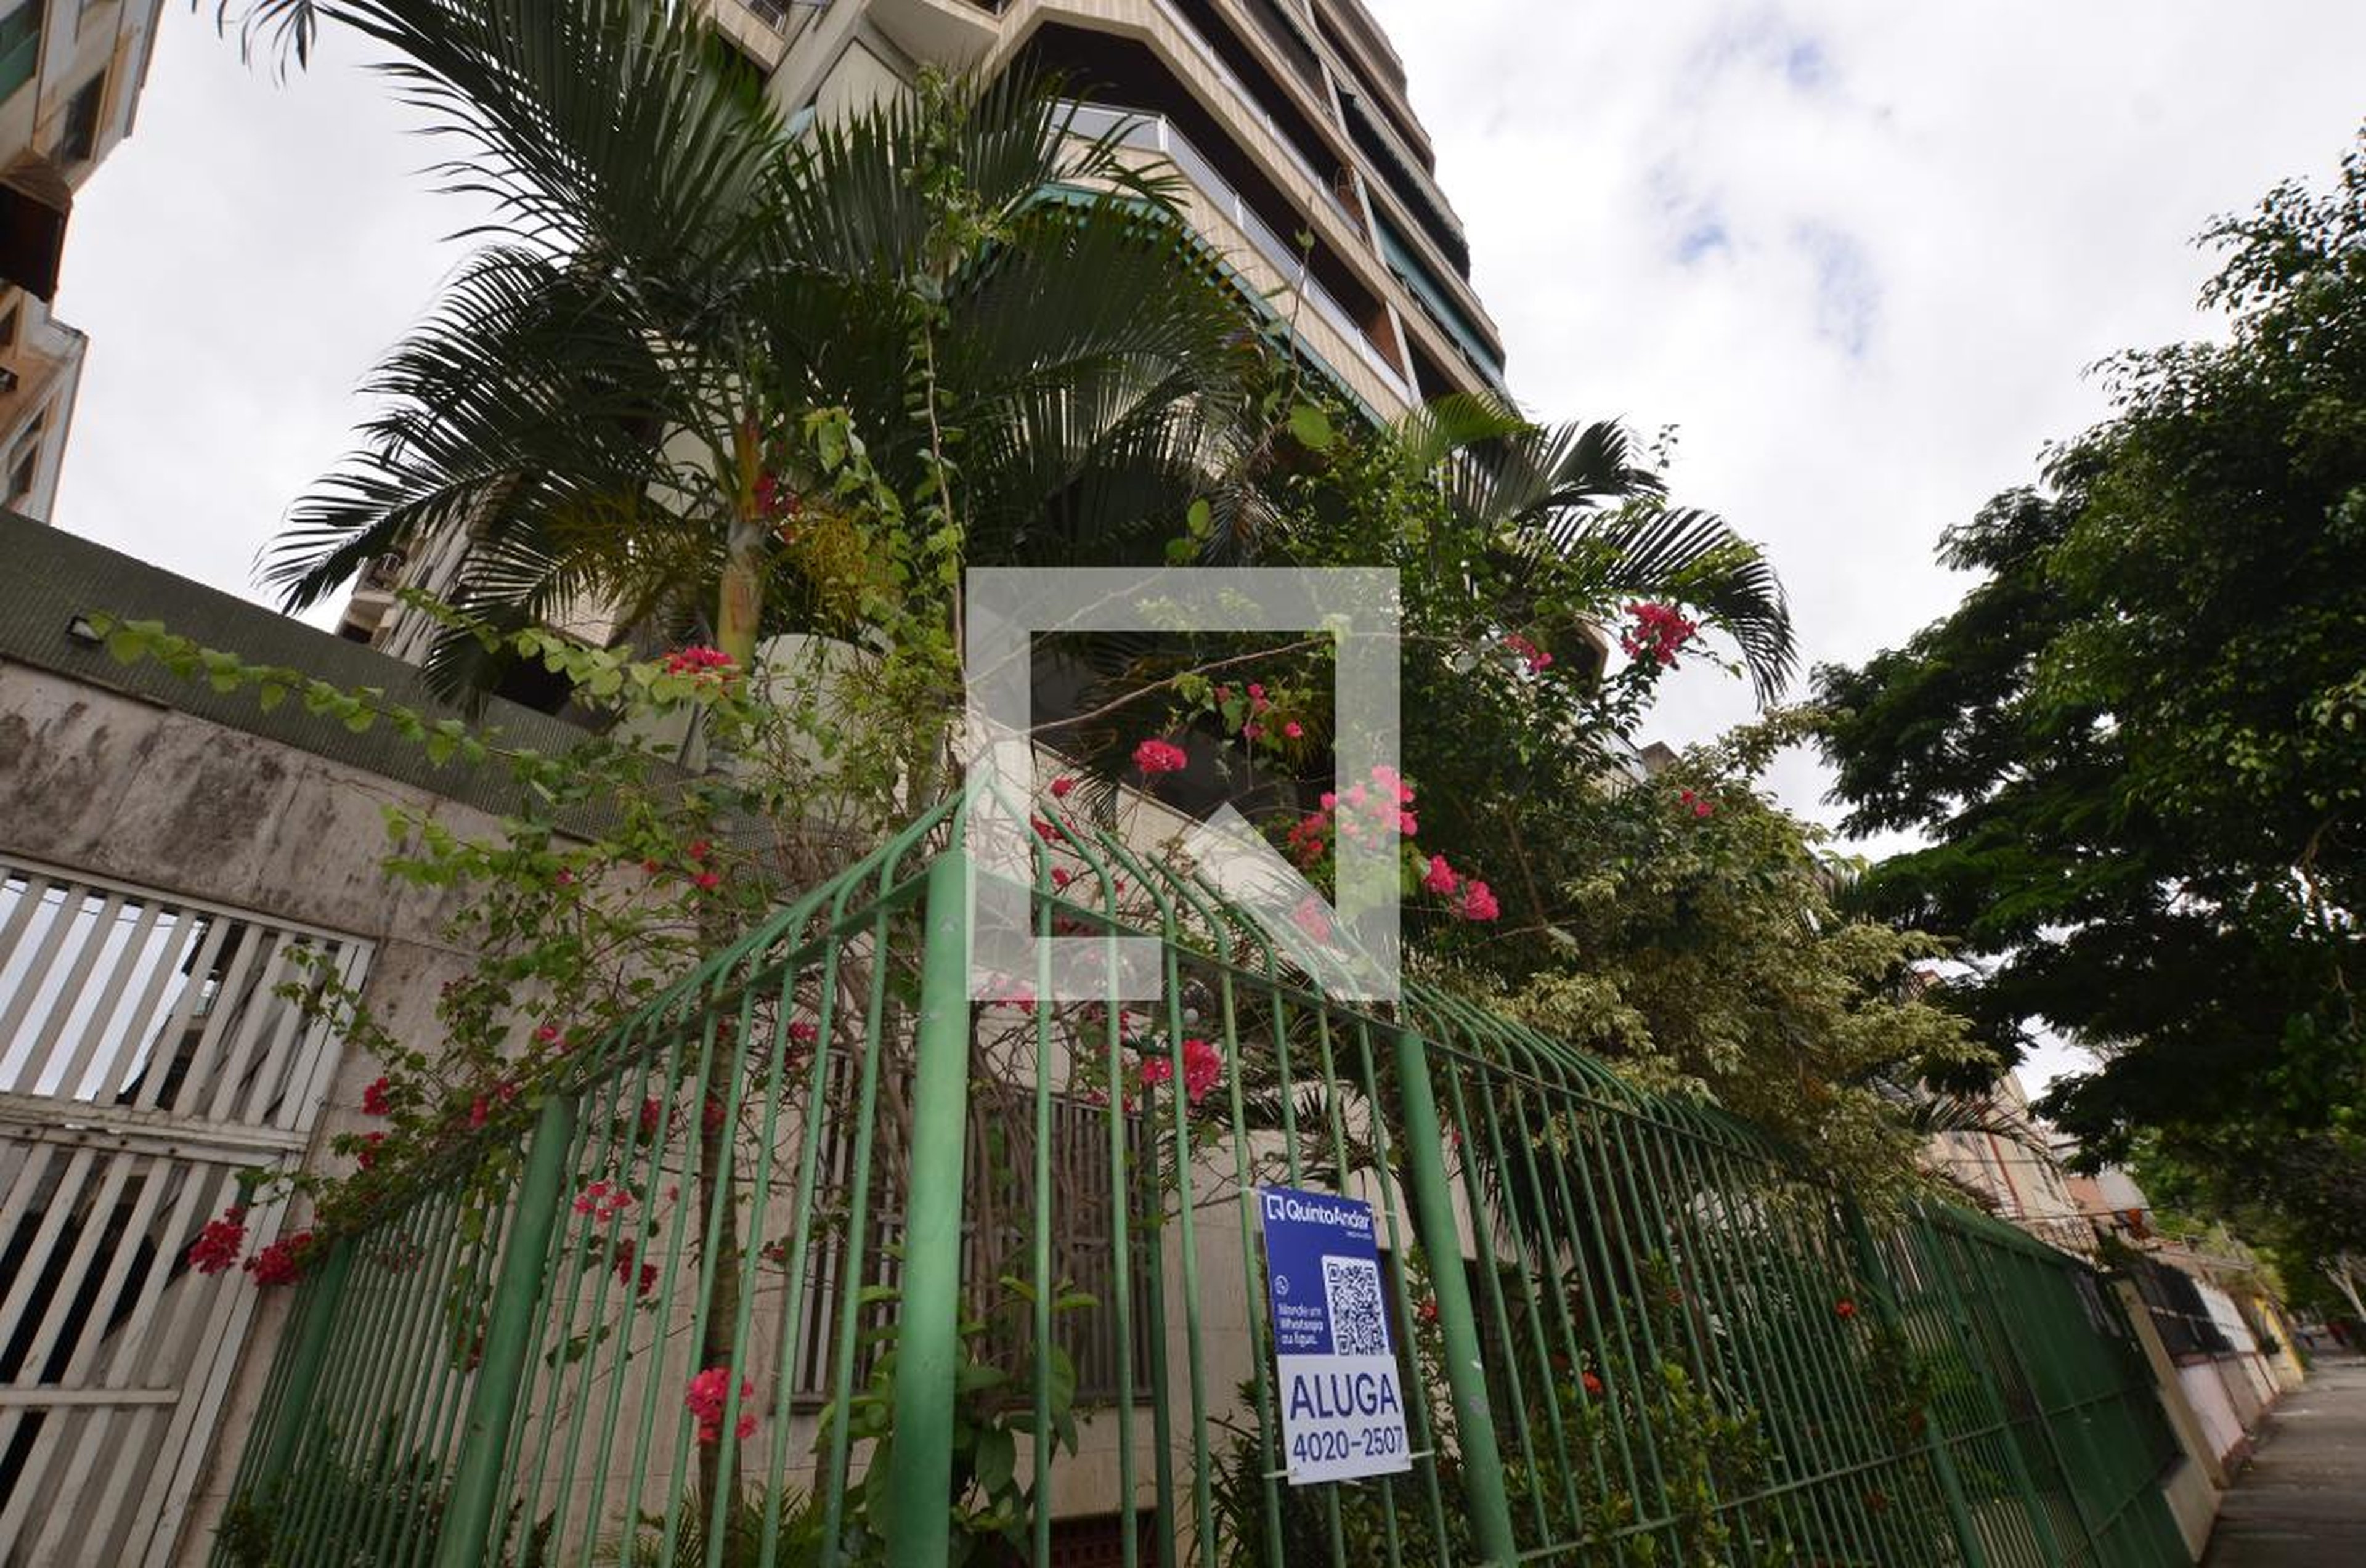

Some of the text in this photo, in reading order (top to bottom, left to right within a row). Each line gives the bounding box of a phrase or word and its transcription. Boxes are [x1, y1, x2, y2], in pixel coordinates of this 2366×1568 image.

[1286, 1200, 1370, 1229] QuintoAndar
[1290, 1373, 1399, 1420] ALUGA
[1293, 1426, 1402, 1462] 4020-2507
